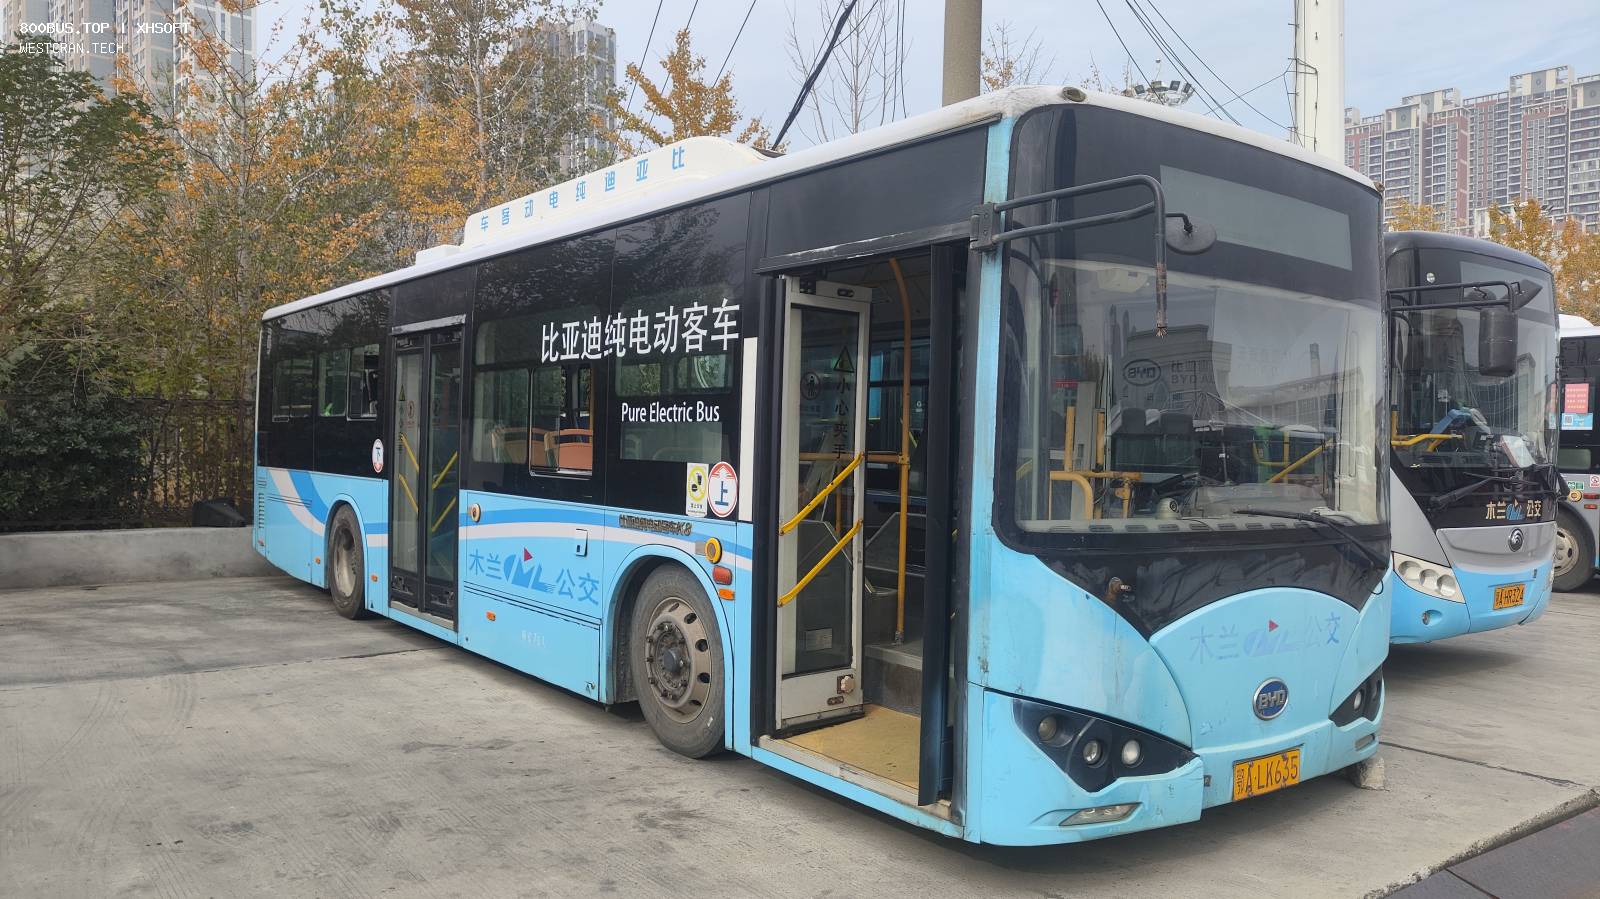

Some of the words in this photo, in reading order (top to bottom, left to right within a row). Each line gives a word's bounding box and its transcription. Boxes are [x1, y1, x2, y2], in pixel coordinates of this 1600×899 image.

[541, 298, 740, 363] 比亚迪纯电动客车
[621, 402, 646, 422] Pure
[650, 401, 693, 422] Electric
[696, 400, 720, 422] Bus
[832, 377, 850, 459] 小心夹手
[714, 480, 729, 506] 上
[1485, 500, 1506, 520] 木兰
[469, 548, 502, 580] 木兰
[556, 567, 600, 605] 公交
[1189, 624, 1239, 664] 木兰
[1303, 611, 1341, 648] 公交
[1258, 689, 1286, 709] BYD
